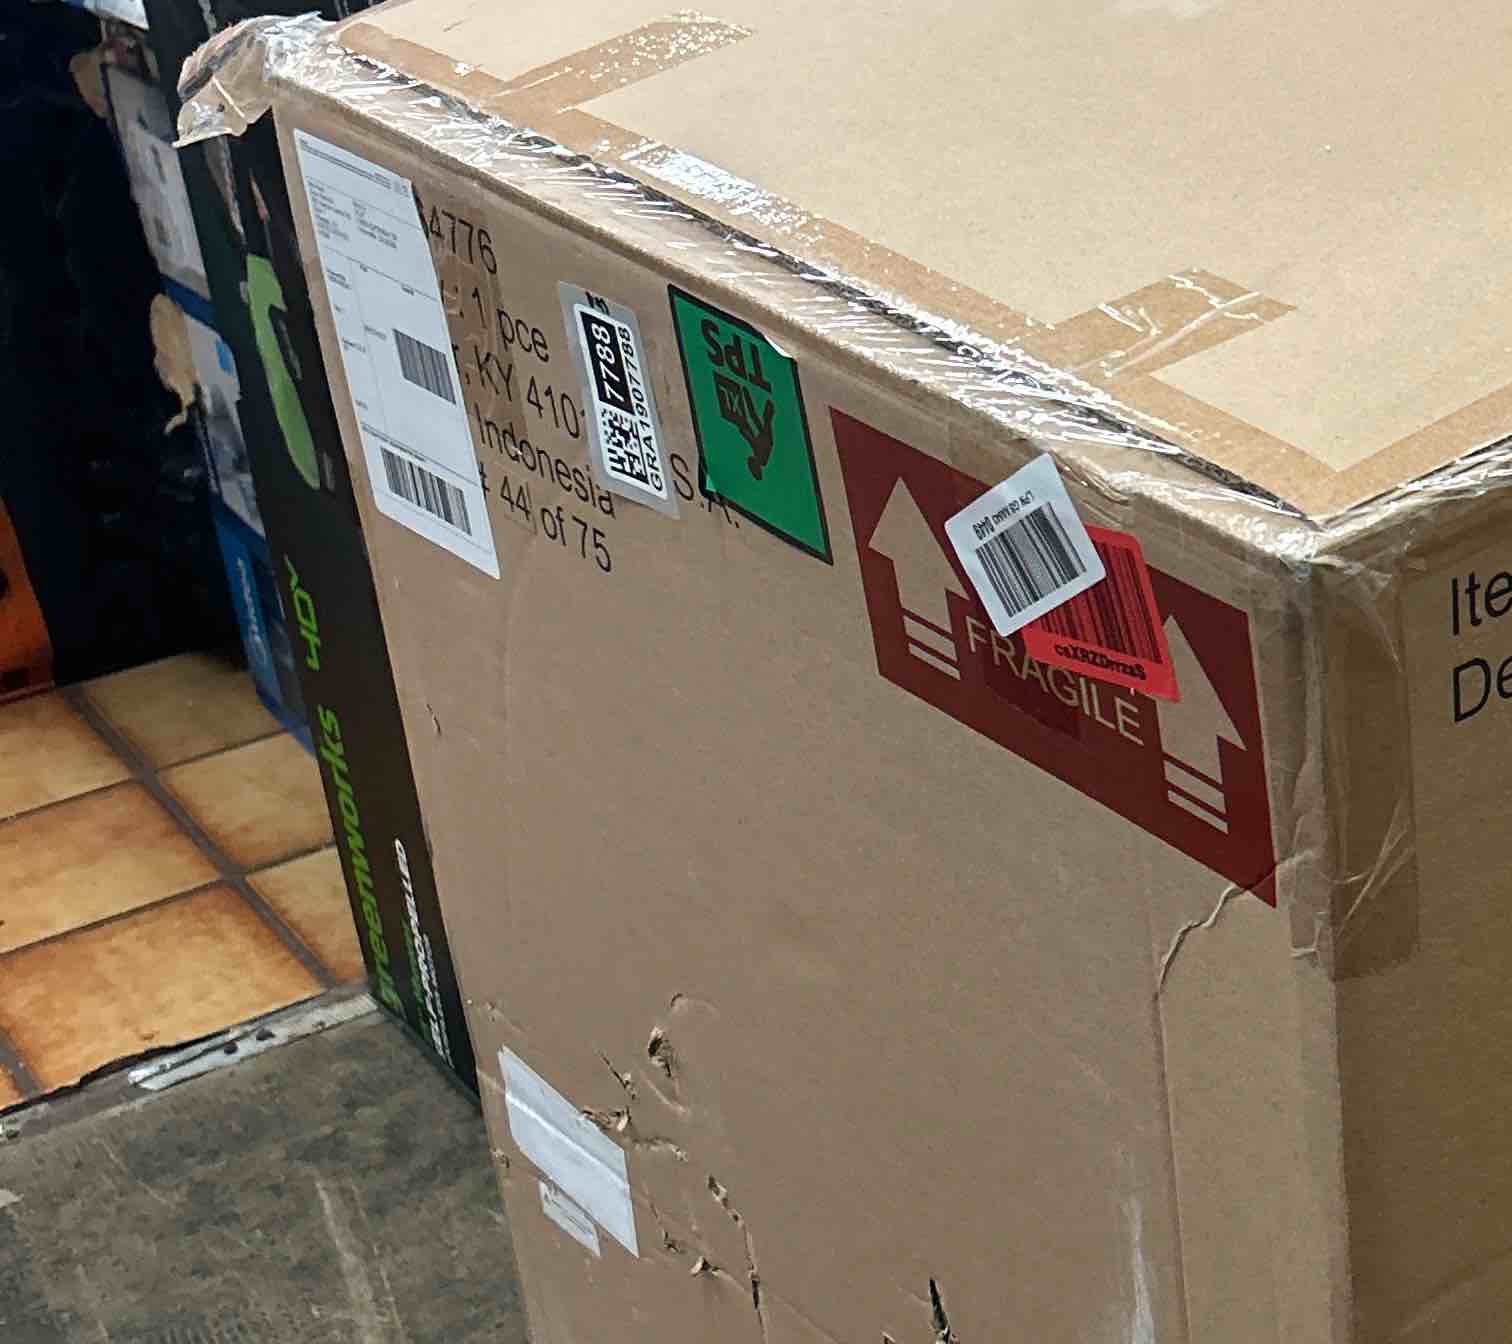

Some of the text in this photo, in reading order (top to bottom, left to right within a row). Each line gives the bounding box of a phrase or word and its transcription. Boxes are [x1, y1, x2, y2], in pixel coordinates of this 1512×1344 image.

[472, 287, 488, 327] 1
[496, 308, 550, 363] pce
[591, 322, 625, 403] 7788
[700, 318, 772, 393] TPS
[474, 344, 513, 402] KY
[619, 327, 664, 492] GRA1907788
[474, 403, 616, 520] Indonesia
[500, 475, 530, 521] 44
[542, 506, 567, 548] of
[572, 516, 612, 573] 75
[965, 614, 1145, 747] FRAGILE
